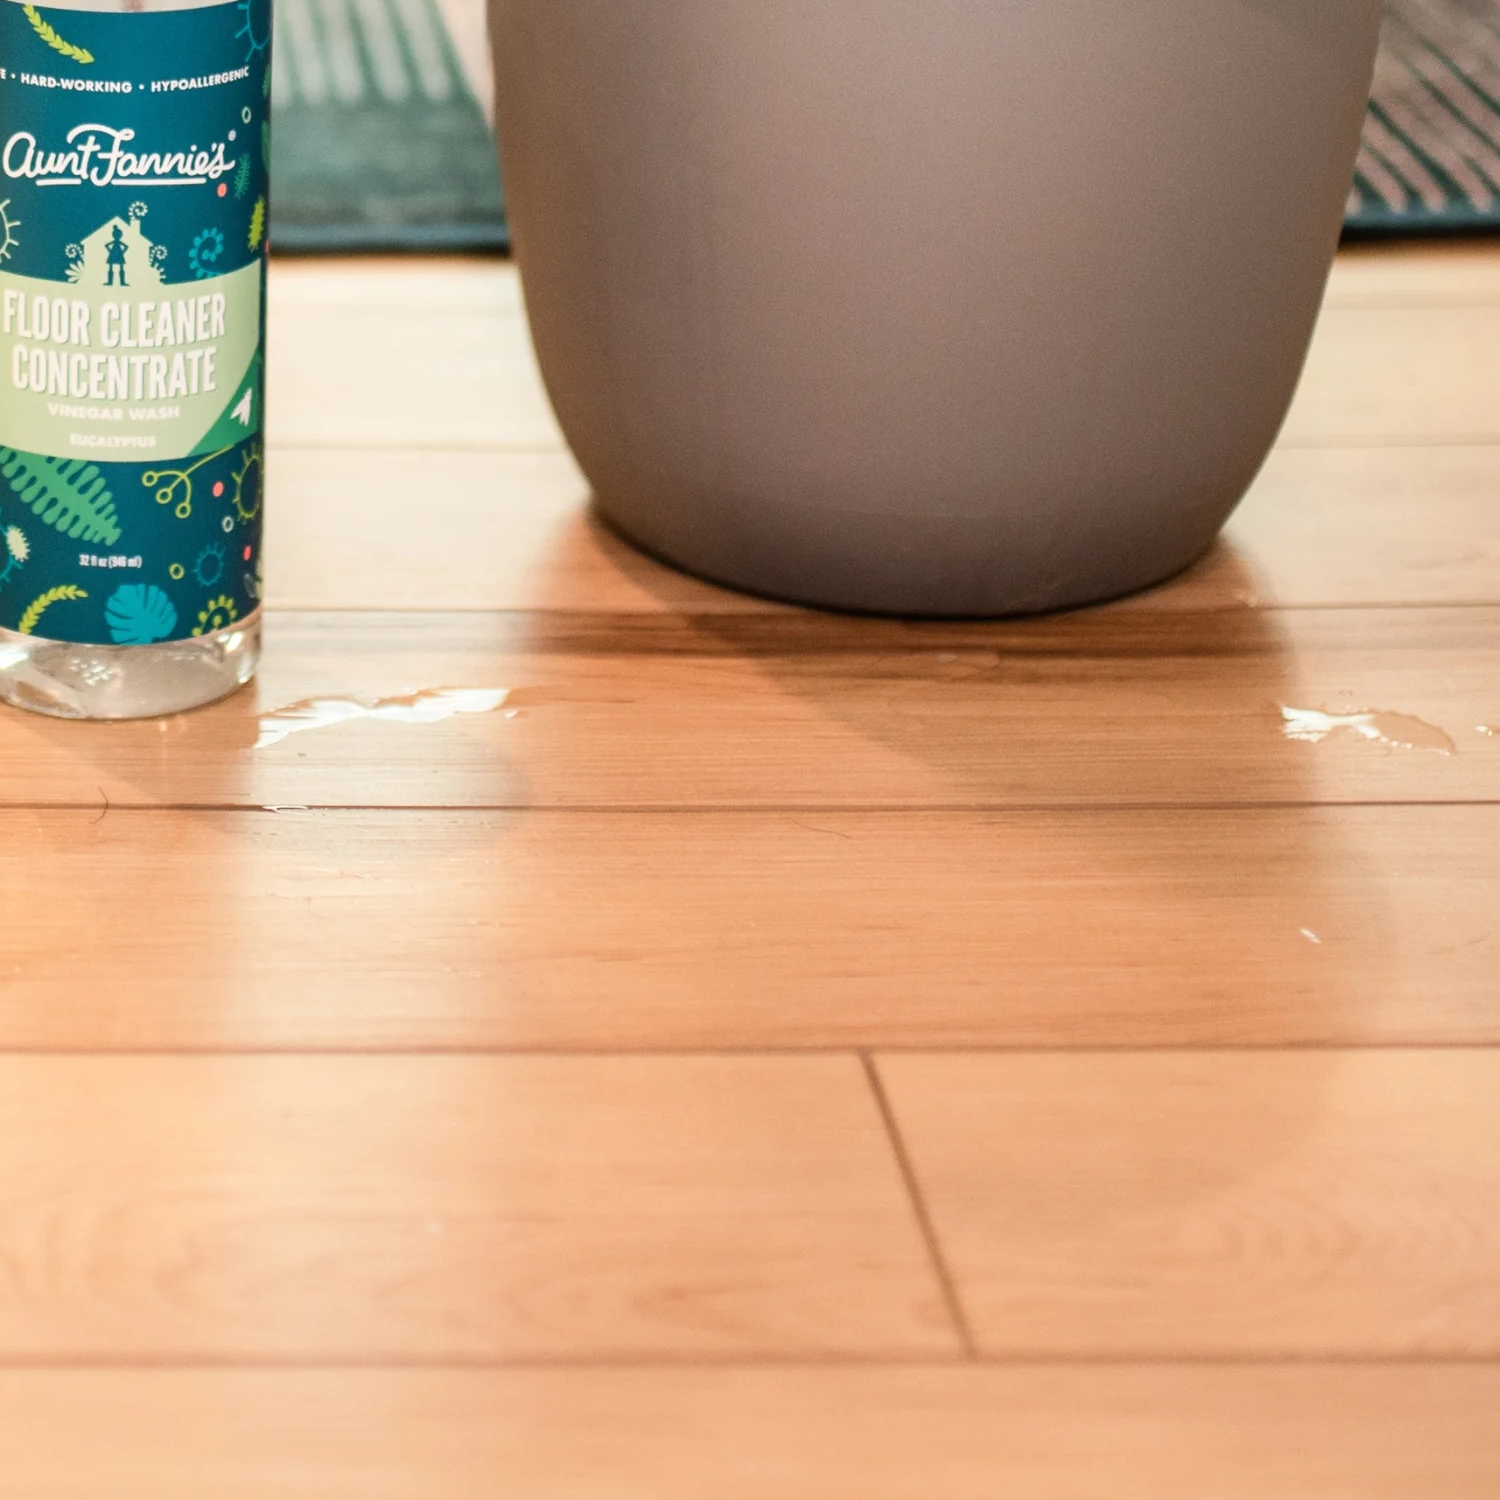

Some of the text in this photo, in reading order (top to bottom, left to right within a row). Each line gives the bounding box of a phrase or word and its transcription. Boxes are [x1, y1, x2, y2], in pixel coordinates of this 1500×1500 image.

[20, 72, 133, 93] HARD-WORKING
[151, 65, 250, 93] HYPOALLERGENIC
[66, 123, 236, 187] Fannie's
[2, 288, 227, 349] FLOOR CLEANER
[11, 344, 218, 401] CONCENTRATE
[47, 402, 181, 421] VINEGAR WASH
[69, 433, 157, 448] EUCALYPTUS
[79, 554, 90, 567] 32
